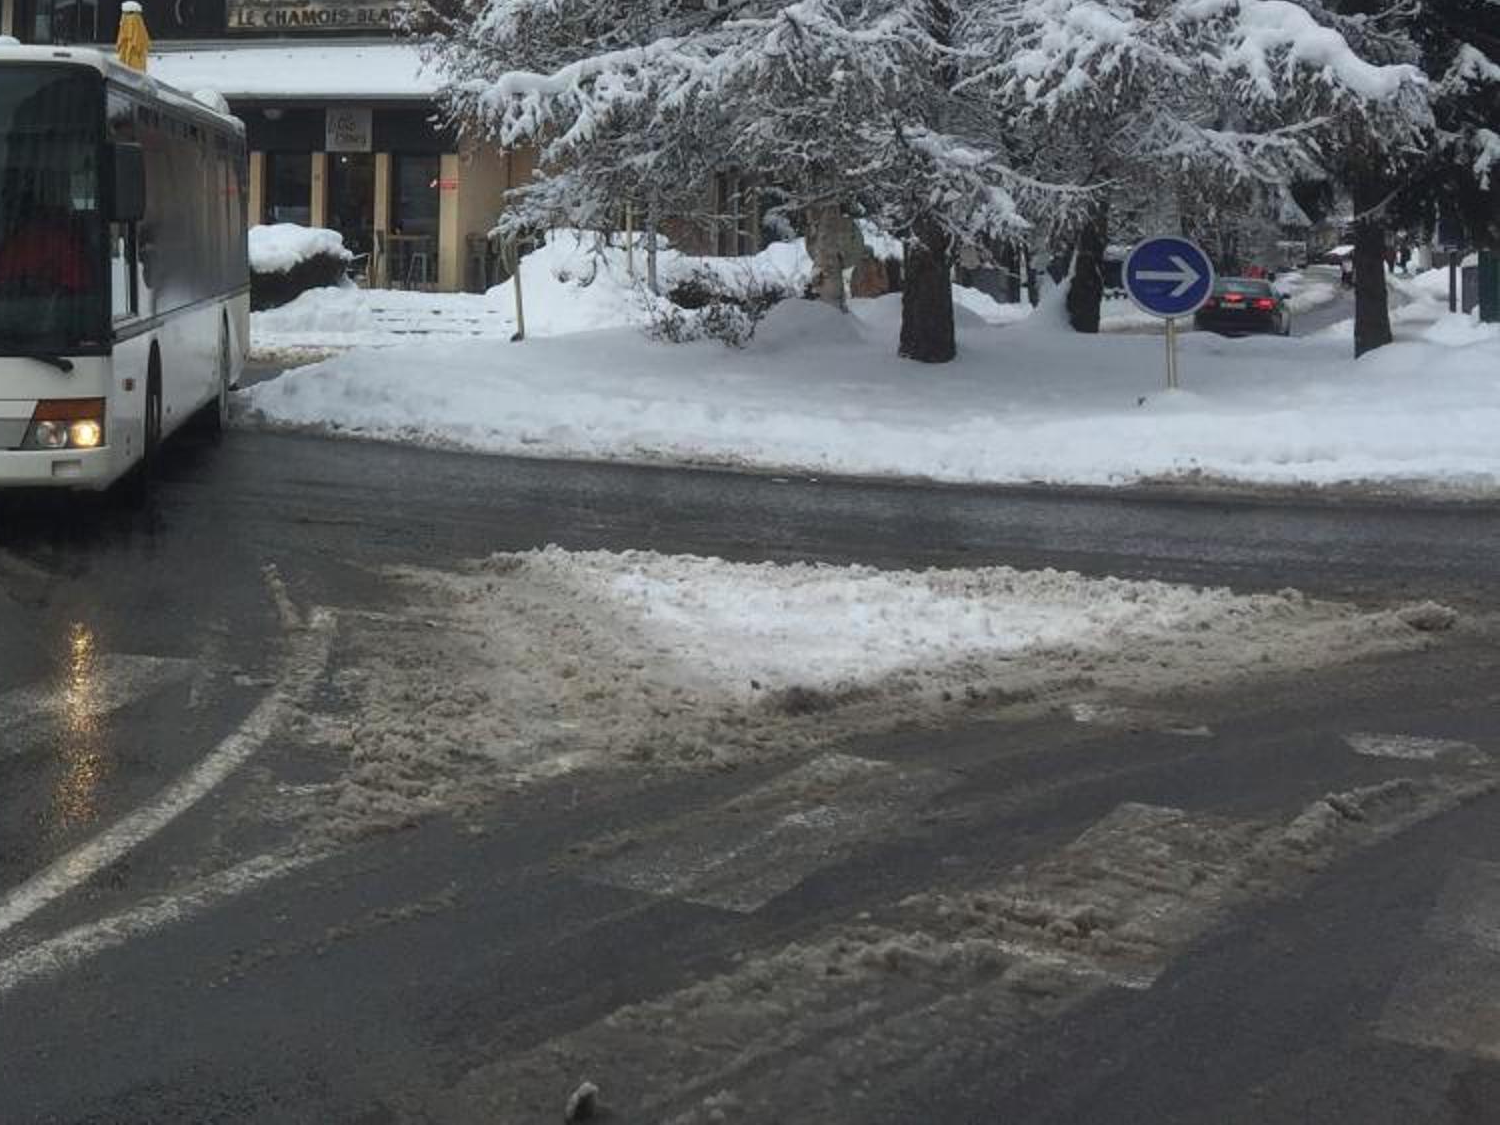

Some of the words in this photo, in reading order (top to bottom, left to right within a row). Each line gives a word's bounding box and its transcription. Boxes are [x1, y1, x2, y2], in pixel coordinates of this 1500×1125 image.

[237, 12, 256, 27] LE
[263, 9, 349, 26] CHAMOIS
[357, 8, 397, 24] BLA
